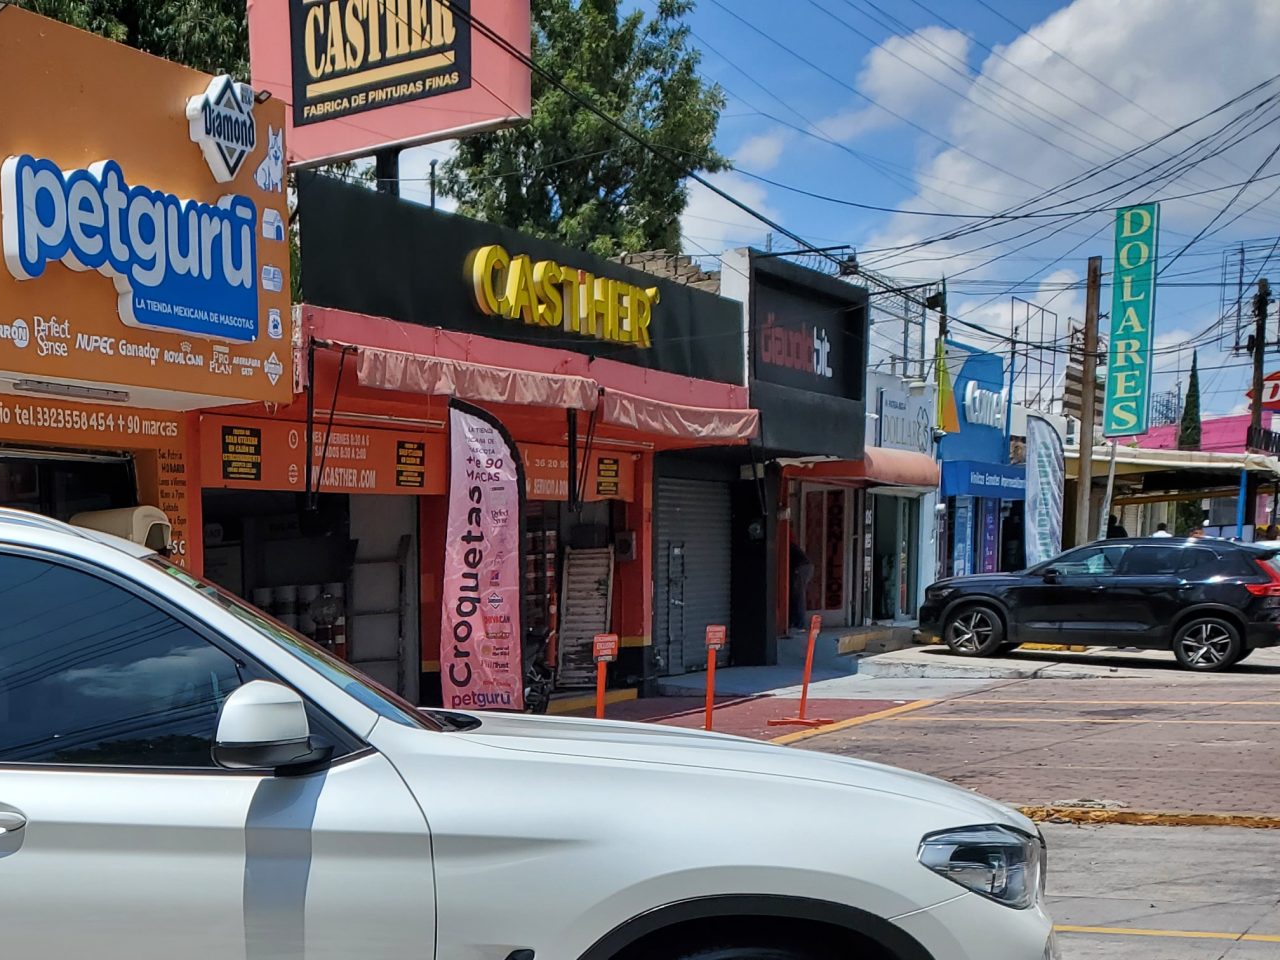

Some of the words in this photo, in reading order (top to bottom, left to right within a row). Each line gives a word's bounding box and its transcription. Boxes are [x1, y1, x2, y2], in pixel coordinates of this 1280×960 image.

[304, 0, 457, 78] CASTHER
[303, 98, 349, 118] FABRICA
[351, 94, 367, 106] DE
[369, 81, 424, 103] PINTURAS
[426, 72, 459, 91] FINAS
[202, 95, 255, 148] Diamond
[473, 245, 652, 348] CASTHER
[136, 298, 146, 310] LA
[147, 300, 172, 314] TIENDA
[173, 305, 209, 321] MEXICANA
[210, 312, 219, 323] DE
[219, 314, 254, 330] MASCOTAS
[1111, 209, 1151, 431] DOLARES
[34, 316, 70, 338] Perfect
[37, 333, 68, 356] Sense
[75, 333, 115, 355] NUPEC
[119, 339, 160, 359] Ganador
[210, 362, 232, 375] PLAN
[213, 351, 229, 364] PRO
[127, 416, 140, 434] 90
[142, 418, 178, 436] marcas
[485, 458, 503, 469] 90
[449, 486, 484, 687] Croquetas
